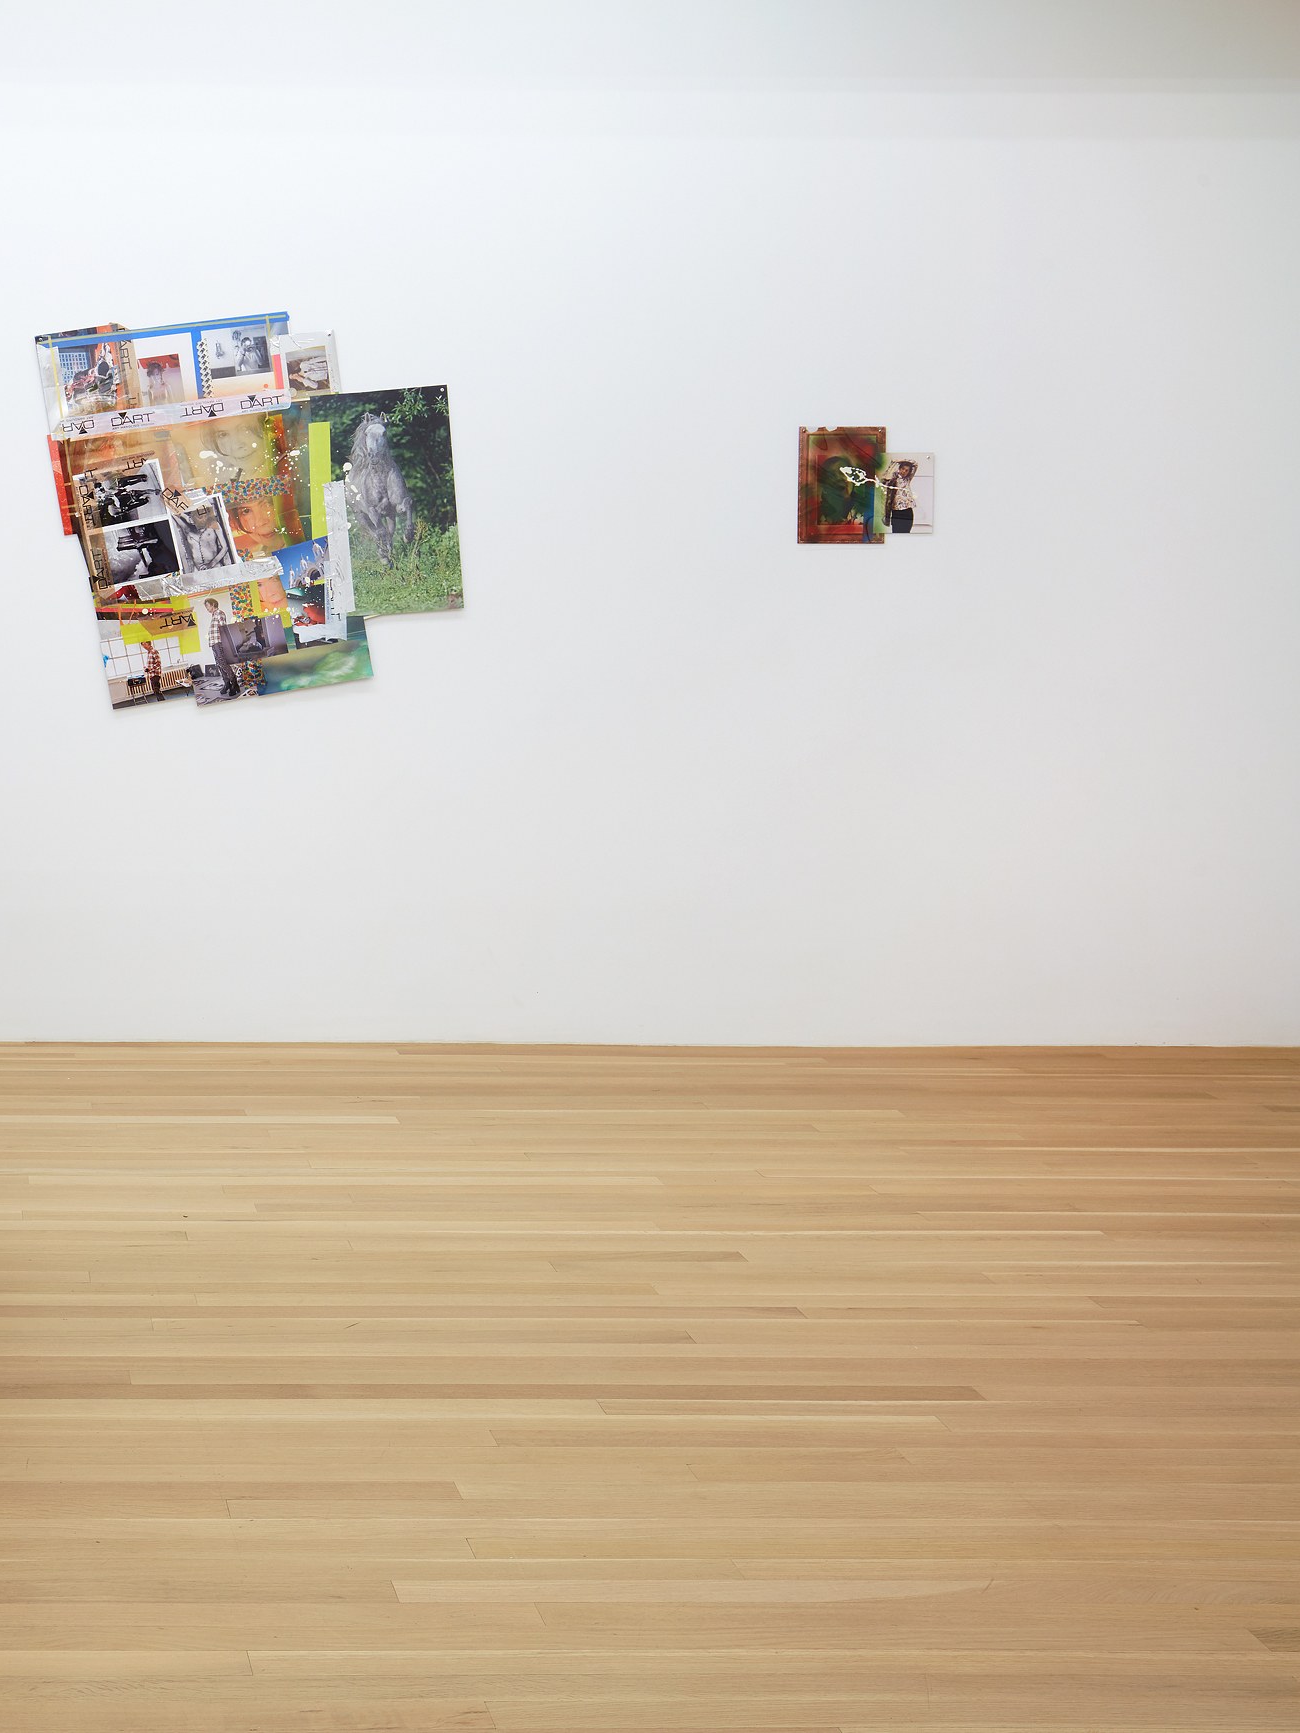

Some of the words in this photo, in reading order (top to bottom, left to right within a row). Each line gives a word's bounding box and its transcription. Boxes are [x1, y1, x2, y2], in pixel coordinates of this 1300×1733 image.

[180, 402, 225, 417] DART
[240, 394, 285, 410] DART
[110, 411, 156, 427] DART
